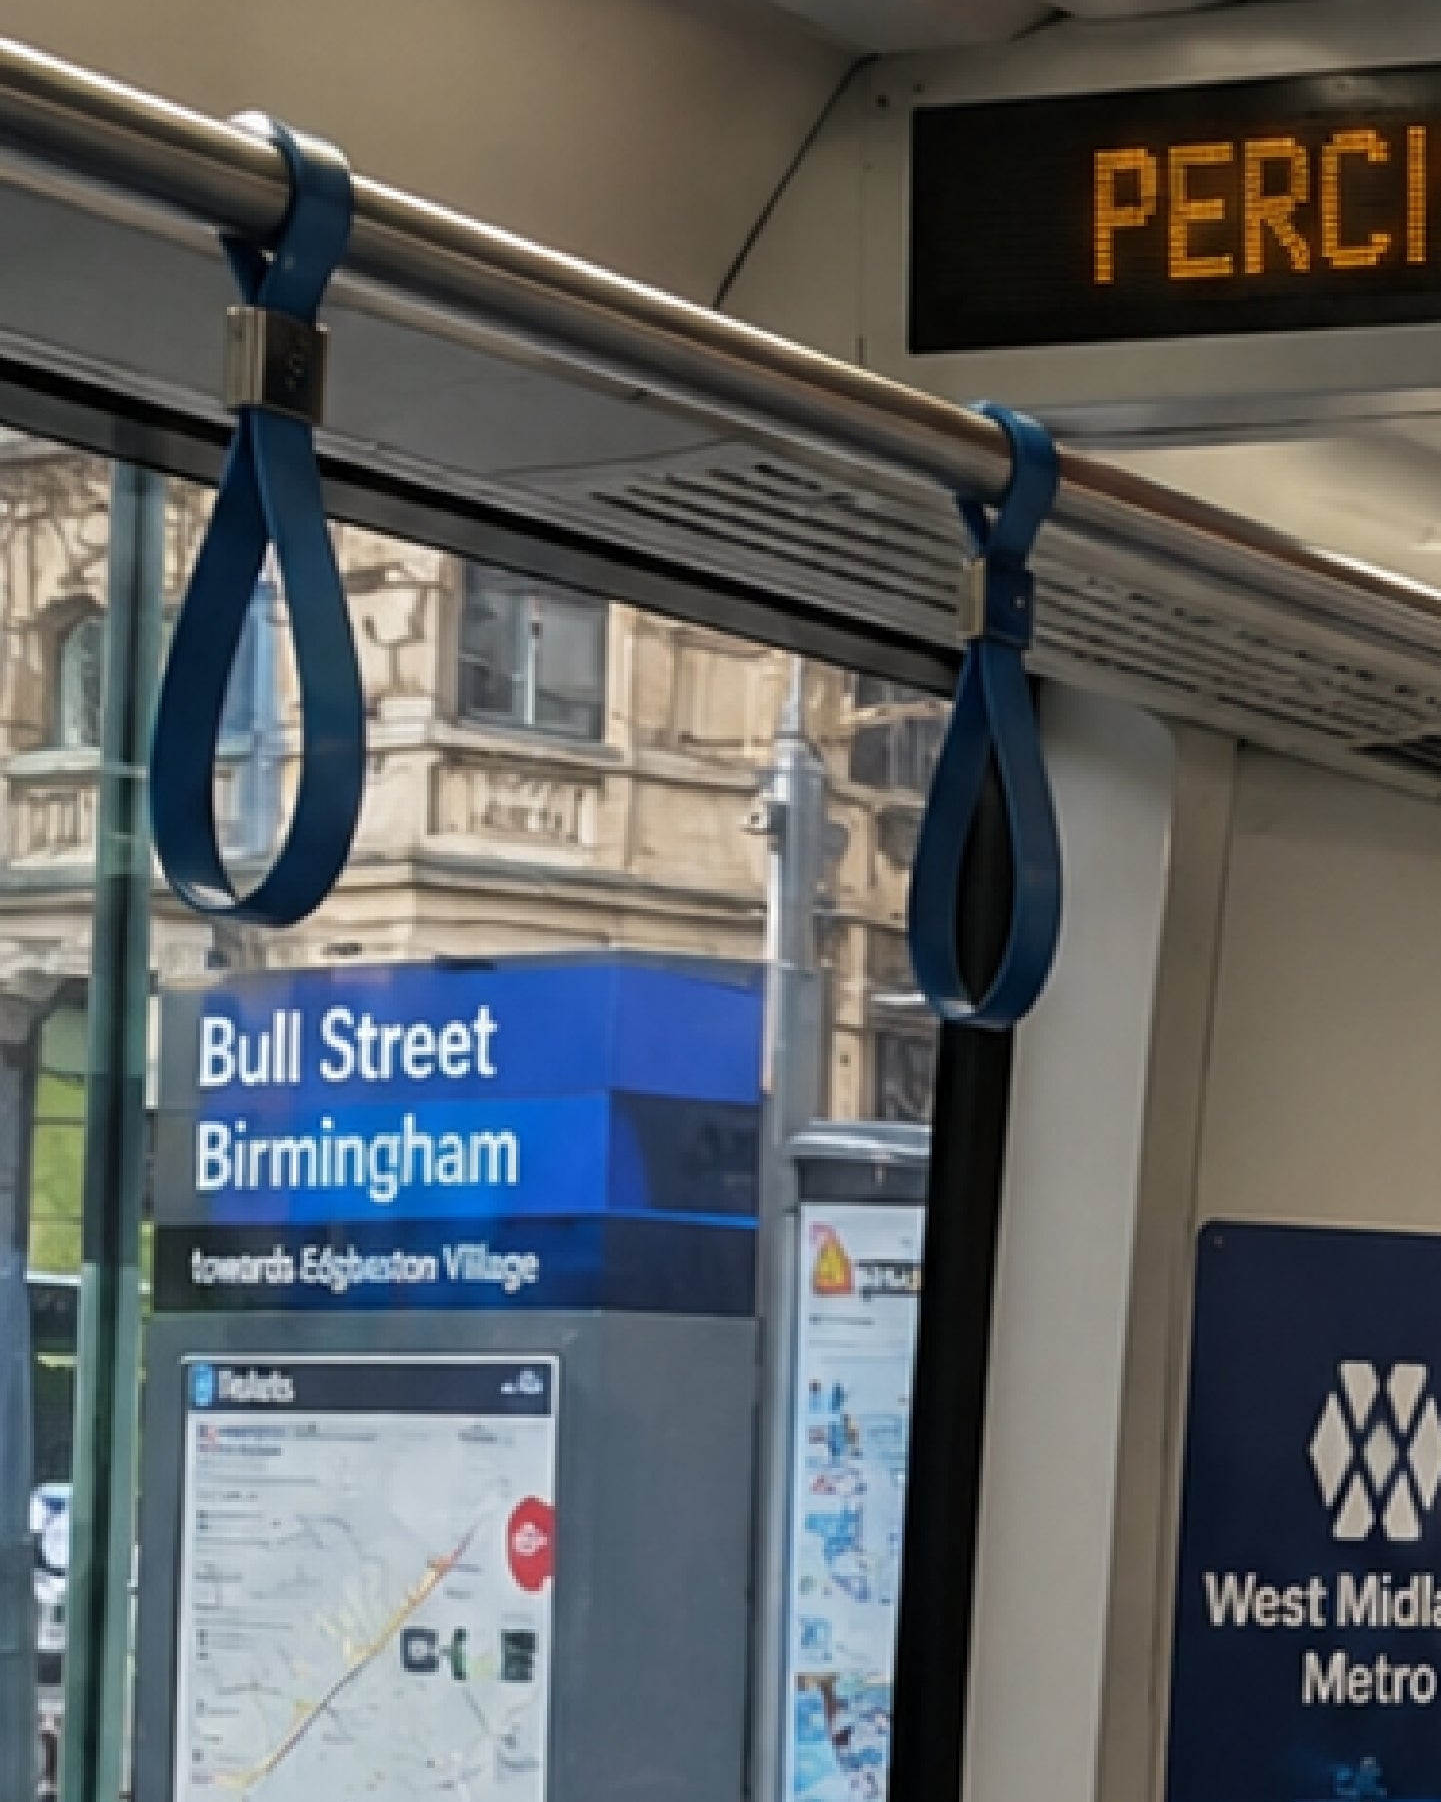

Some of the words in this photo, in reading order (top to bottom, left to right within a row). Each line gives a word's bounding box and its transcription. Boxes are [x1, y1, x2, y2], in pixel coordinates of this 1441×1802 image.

[199, 1008, 301, 1087] Bull
[319, 1004, 498, 1082] Street
[196, 1112, 520, 1204] Birmingham
[191, 1244, 294, 1284] towards
[300, 1244, 439, 1294] Edgbaston
[443, 1241, 540, 1294] Village
[1204, 1570, 1328, 1629] West
[1300, 1651, 1438, 1705] Metro
